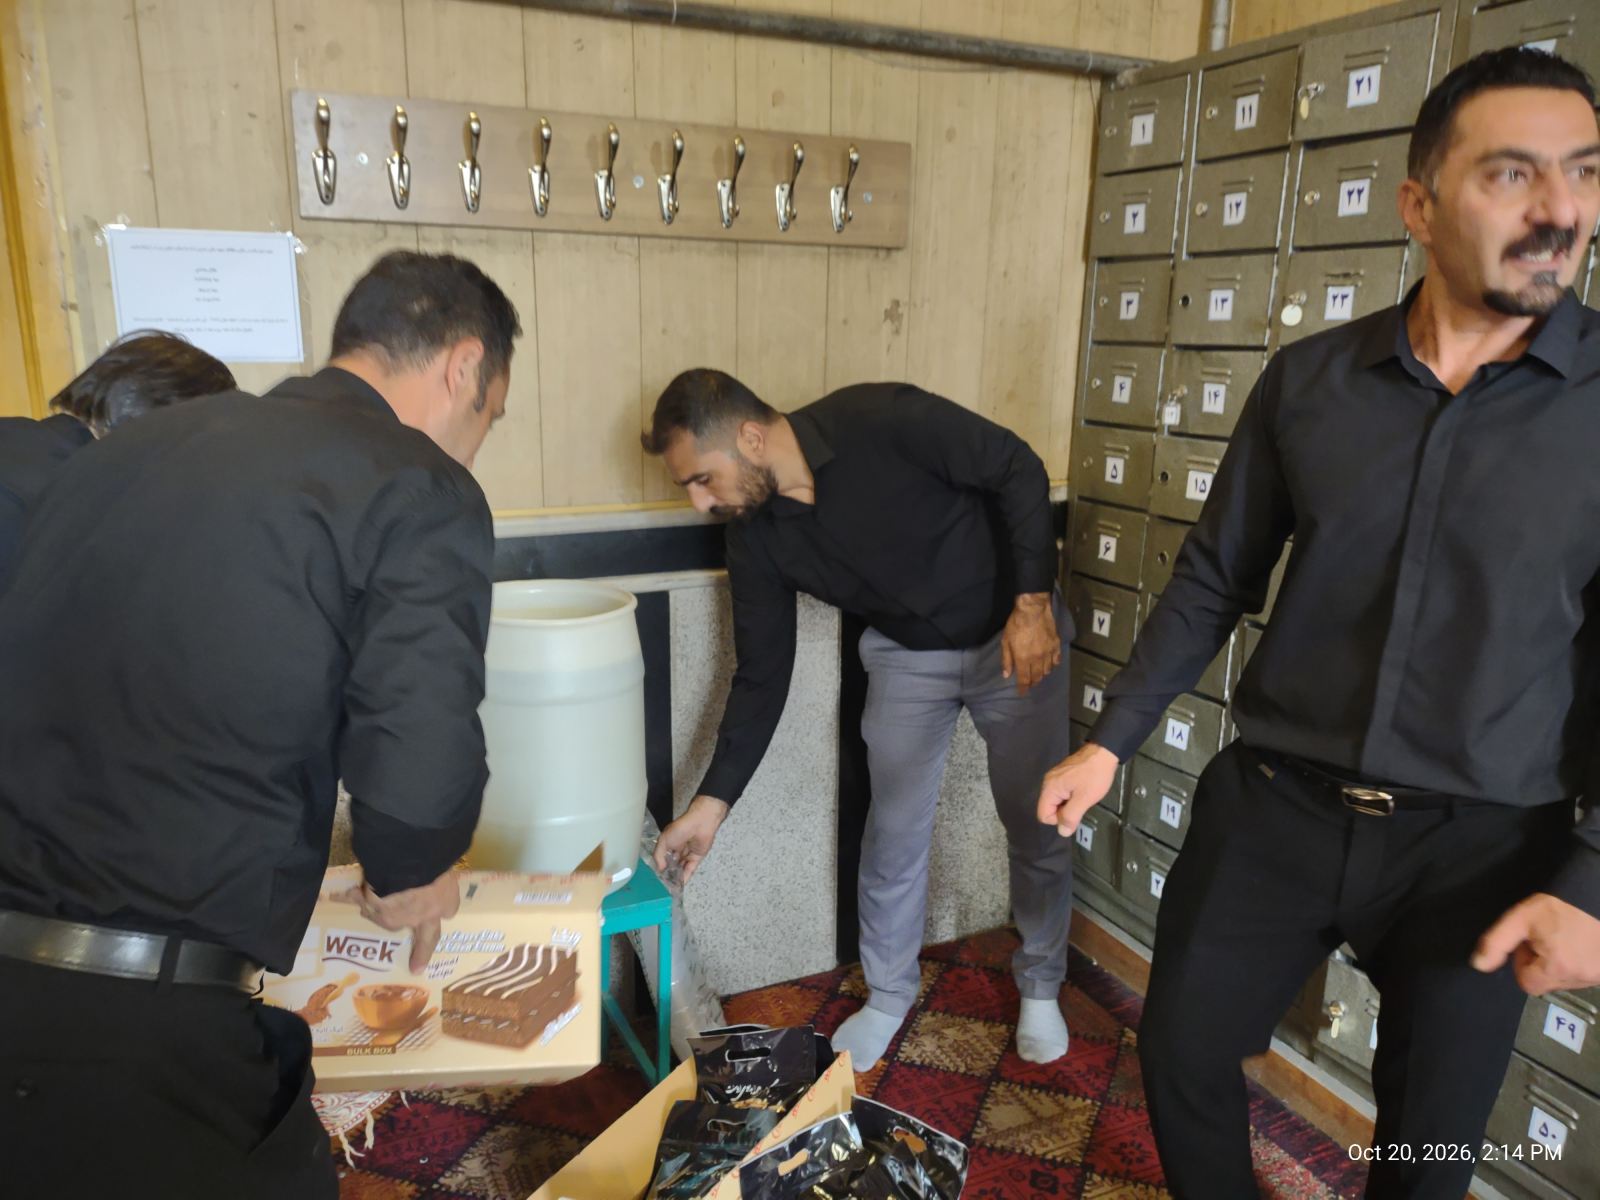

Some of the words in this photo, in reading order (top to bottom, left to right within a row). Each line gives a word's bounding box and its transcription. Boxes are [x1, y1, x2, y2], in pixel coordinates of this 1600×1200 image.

[1355, 76, 1372, 94] ۲۱
[1241, 104, 1253, 122] ۱۱
[1346, 186, 1365, 205] ۲۲
[1227, 199, 1243, 219] ۱۲
[1131, 210, 1140, 227] ۲
[1125, 299, 1135, 315] ۳
[1214, 298, 1229, 313] ۱۳
[1331, 293, 1349, 308] ۲۳
[1118, 381, 1126, 397] ۴
[1207, 389, 1220, 405] ۱۴
[1110, 464, 1119, 479] ۵
[1195, 478, 1207, 493] ۱۵
[1103, 541, 1111, 556] ۶
[1097, 616, 1105, 632] ۷
[1089, 694, 1098, 708] ۸
[1171, 726, 1184, 742] ۱۸
[1166, 803, 1177, 820] ۱۹
[1079, 830, 1089, 843] ۱۰
[325, 936, 394, 963] Week
[1555, 1015, 1577, 1039] ۴۹
[1538, 1122, 1557, 1140] ۵۰
